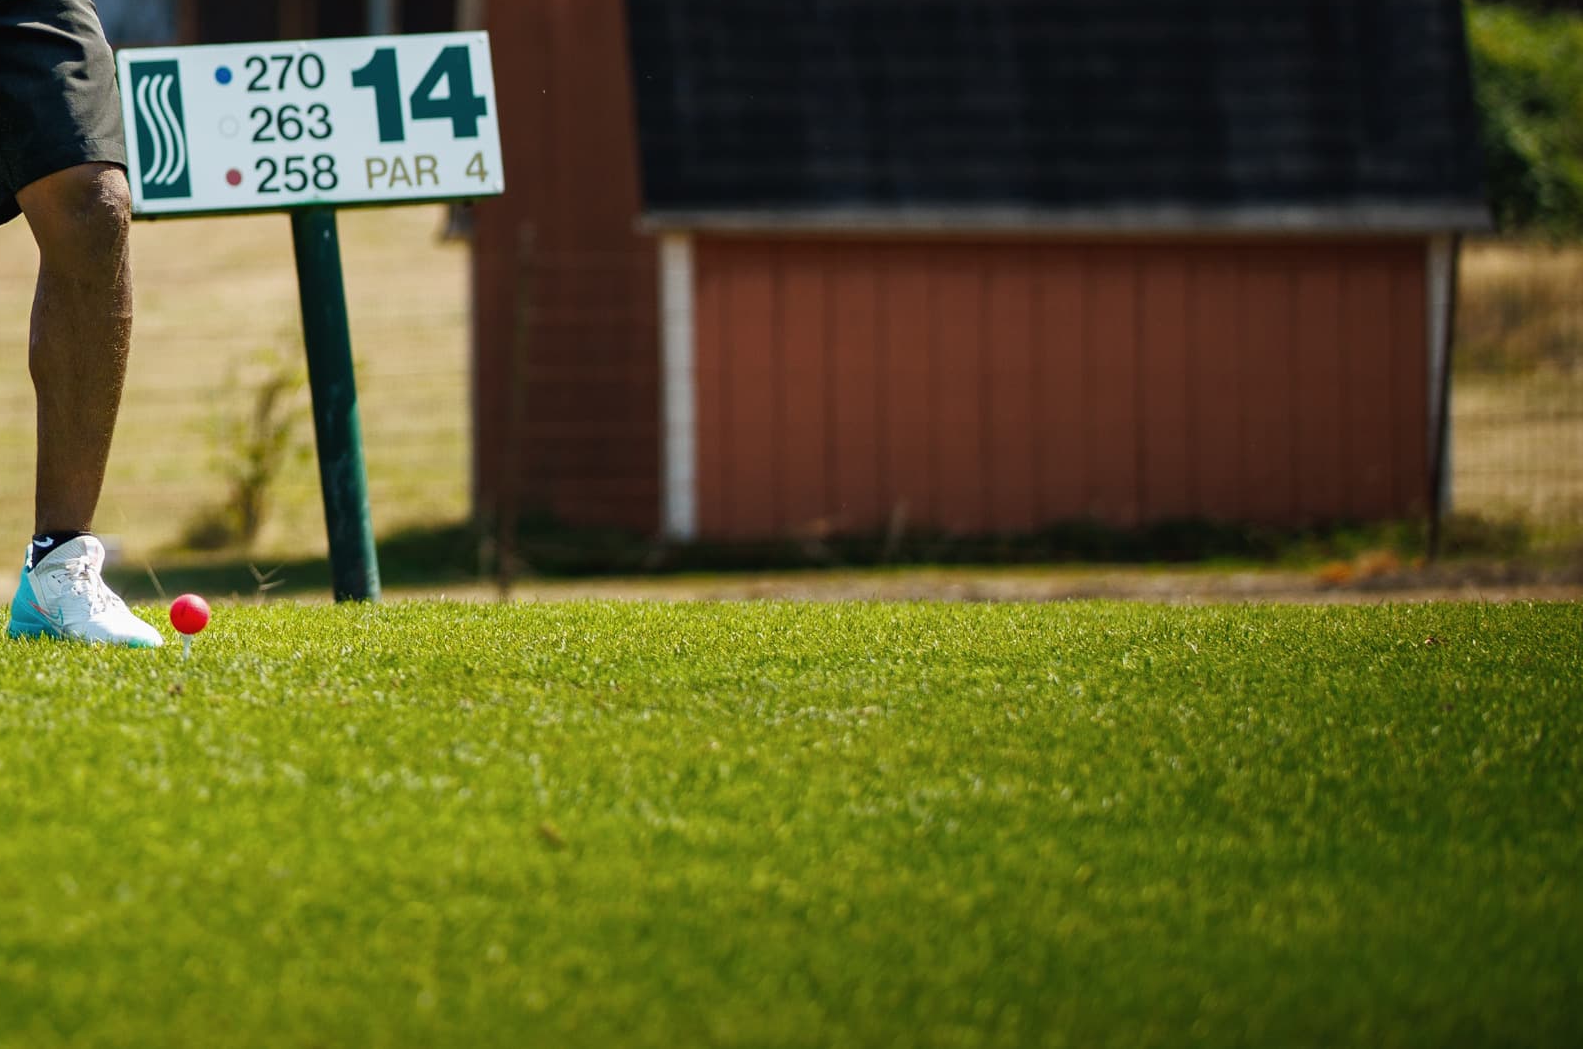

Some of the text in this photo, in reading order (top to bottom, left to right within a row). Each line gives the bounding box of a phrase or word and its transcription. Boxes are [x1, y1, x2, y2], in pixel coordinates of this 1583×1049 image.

[244, 52, 326, 92] 270
[351, 45, 488, 143] 14
[250, 103, 333, 143] 263
[255, 153, 339, 194] 258
[365, 152, 488, 189] PAR 4
